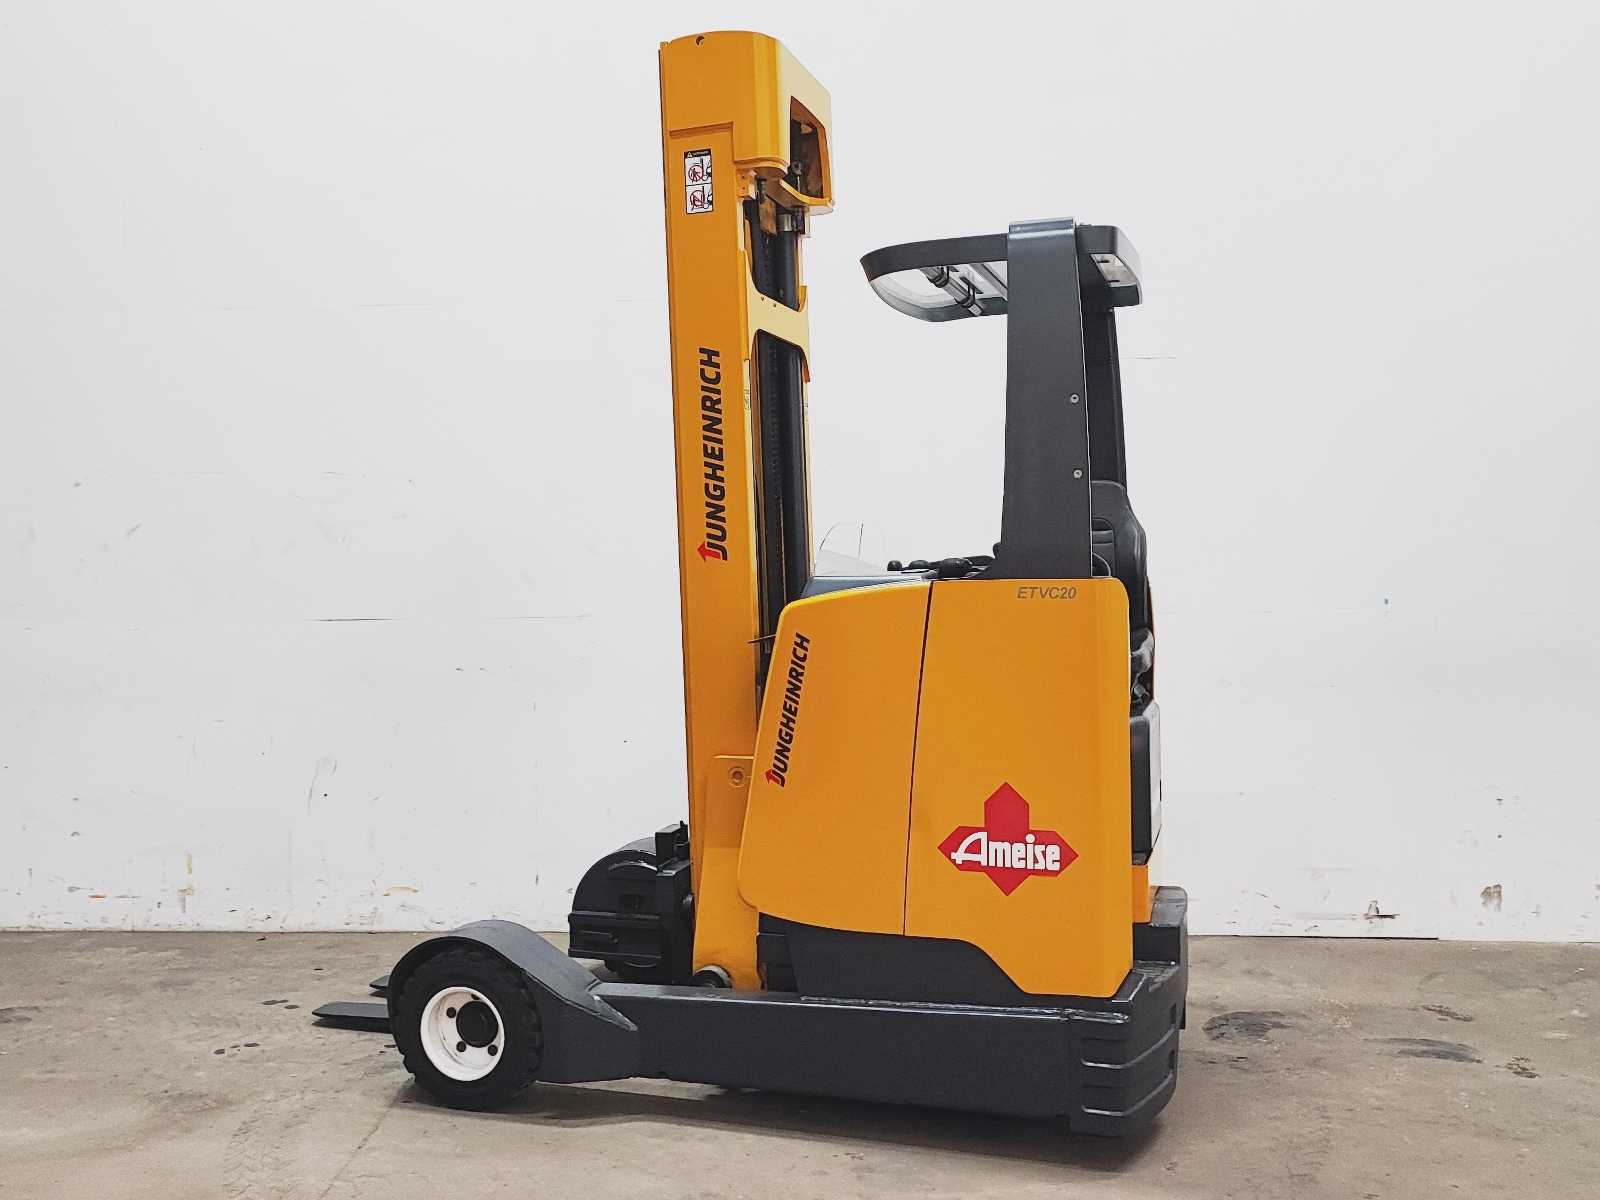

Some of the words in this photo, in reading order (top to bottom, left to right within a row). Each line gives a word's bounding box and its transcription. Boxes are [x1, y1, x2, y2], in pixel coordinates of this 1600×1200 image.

[698, 347, 728, 561] JUNGHEINRICH
[1017, 586, 1077, 600] ETVC20
[767, 632, 811, 788] JUNGHEINRICH
[951, 831, 1061, 871] Ameise
